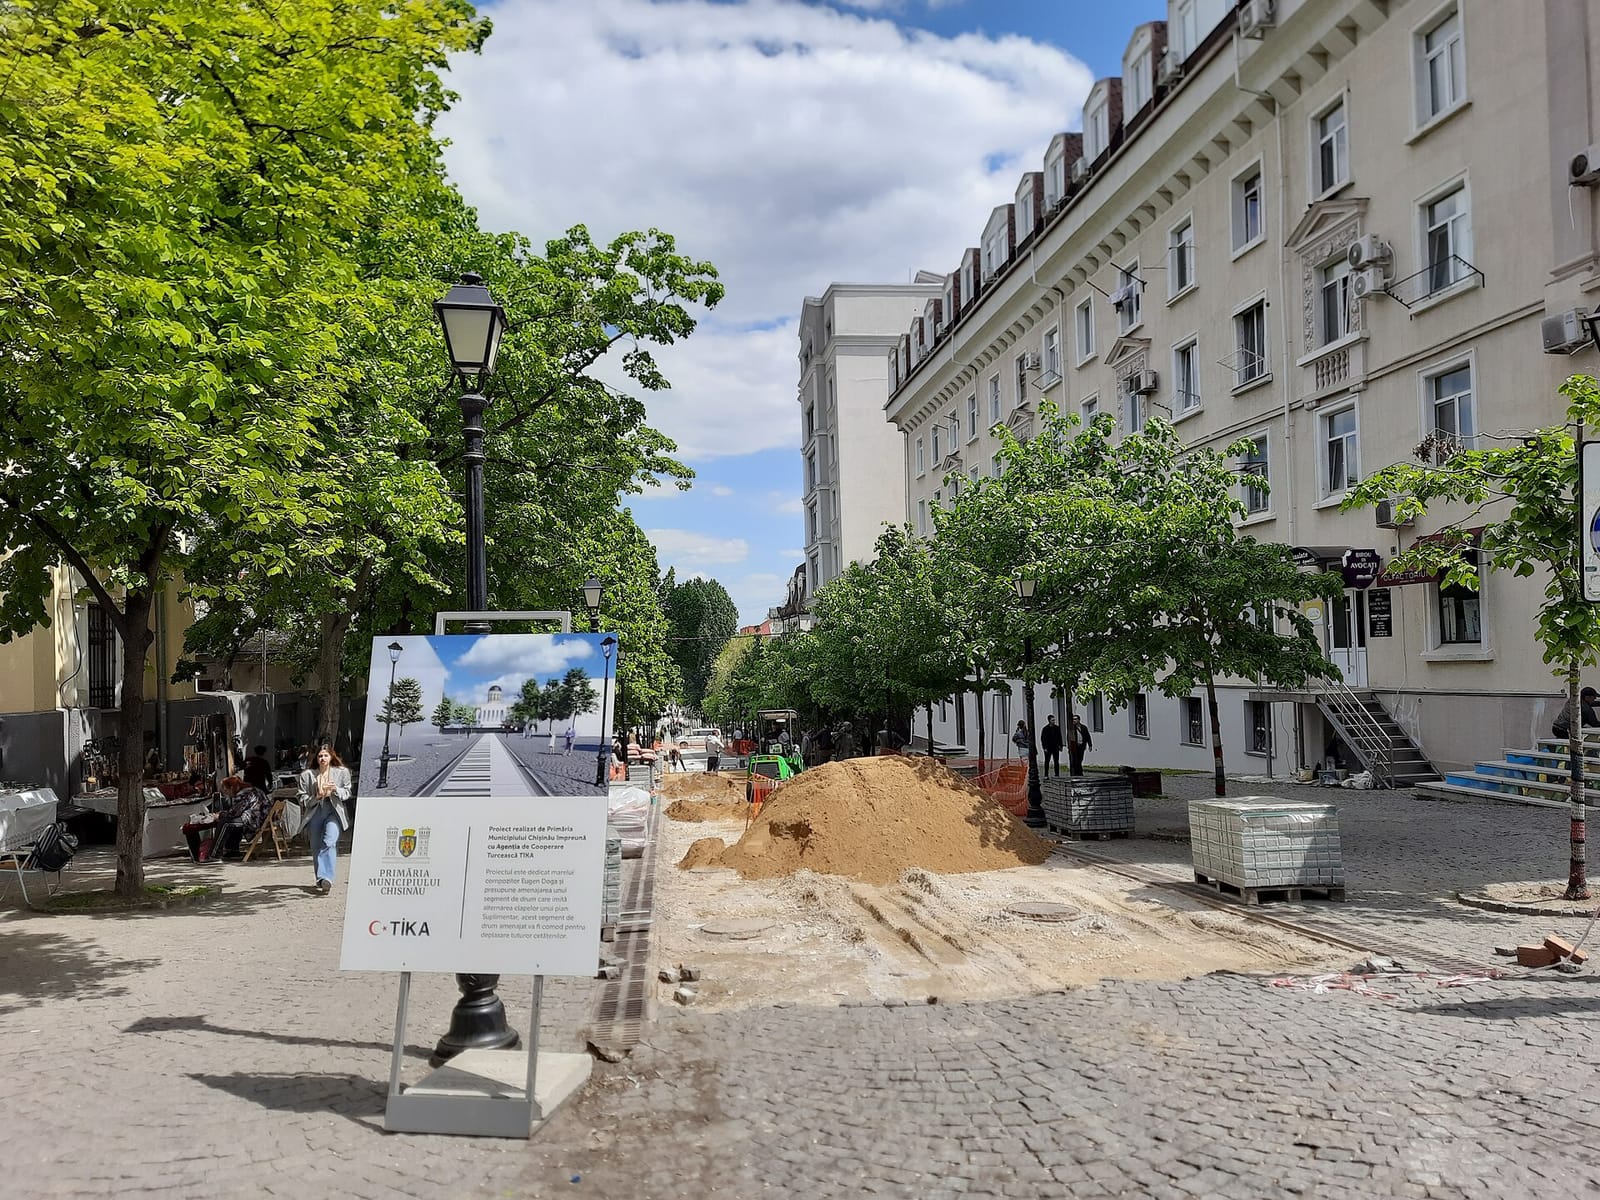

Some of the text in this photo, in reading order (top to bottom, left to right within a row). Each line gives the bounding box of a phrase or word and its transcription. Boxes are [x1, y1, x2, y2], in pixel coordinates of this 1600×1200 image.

[1383, 569, 1428, 581] OLFACTORIU
[379, 868, 430, 878] PRIMĂRIA
[367, 878, 440, 887] MUNICIPIULUI
